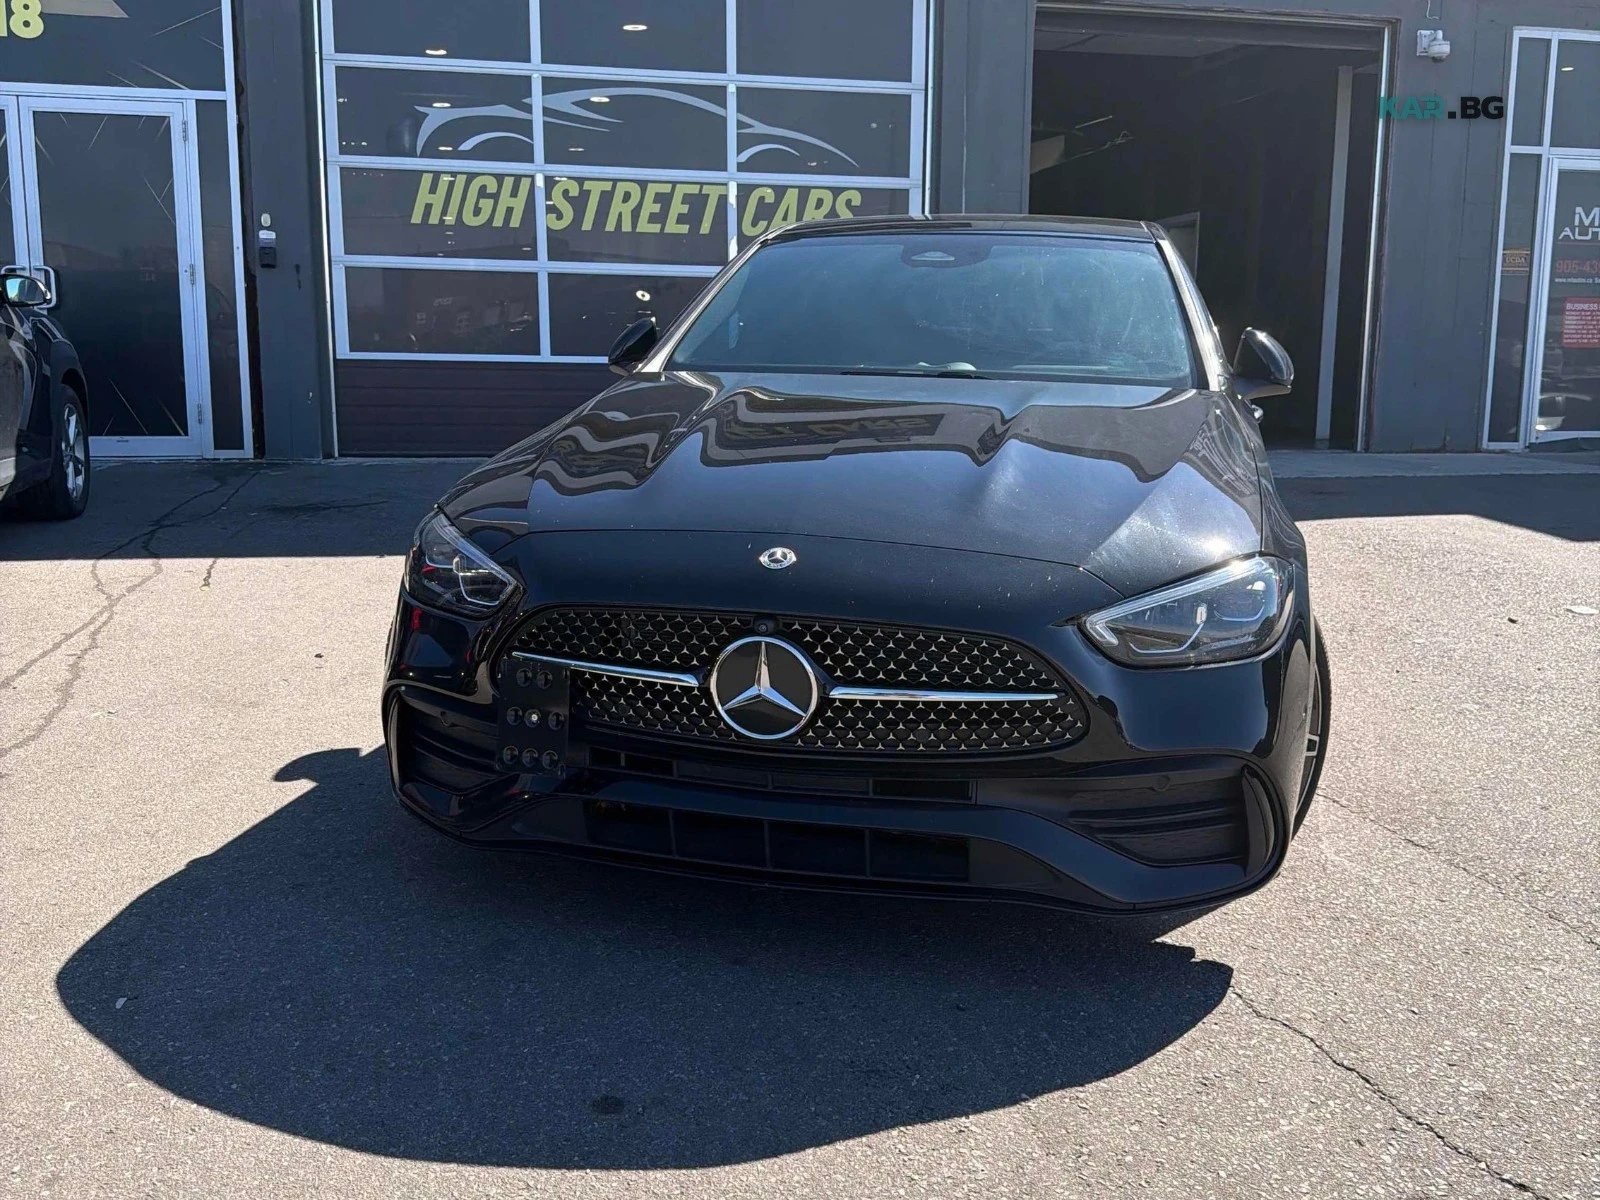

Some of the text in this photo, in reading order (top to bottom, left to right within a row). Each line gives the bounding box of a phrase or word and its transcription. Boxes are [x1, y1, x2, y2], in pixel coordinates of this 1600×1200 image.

[410, 172, 862, 237] HIGH STREET CARS
